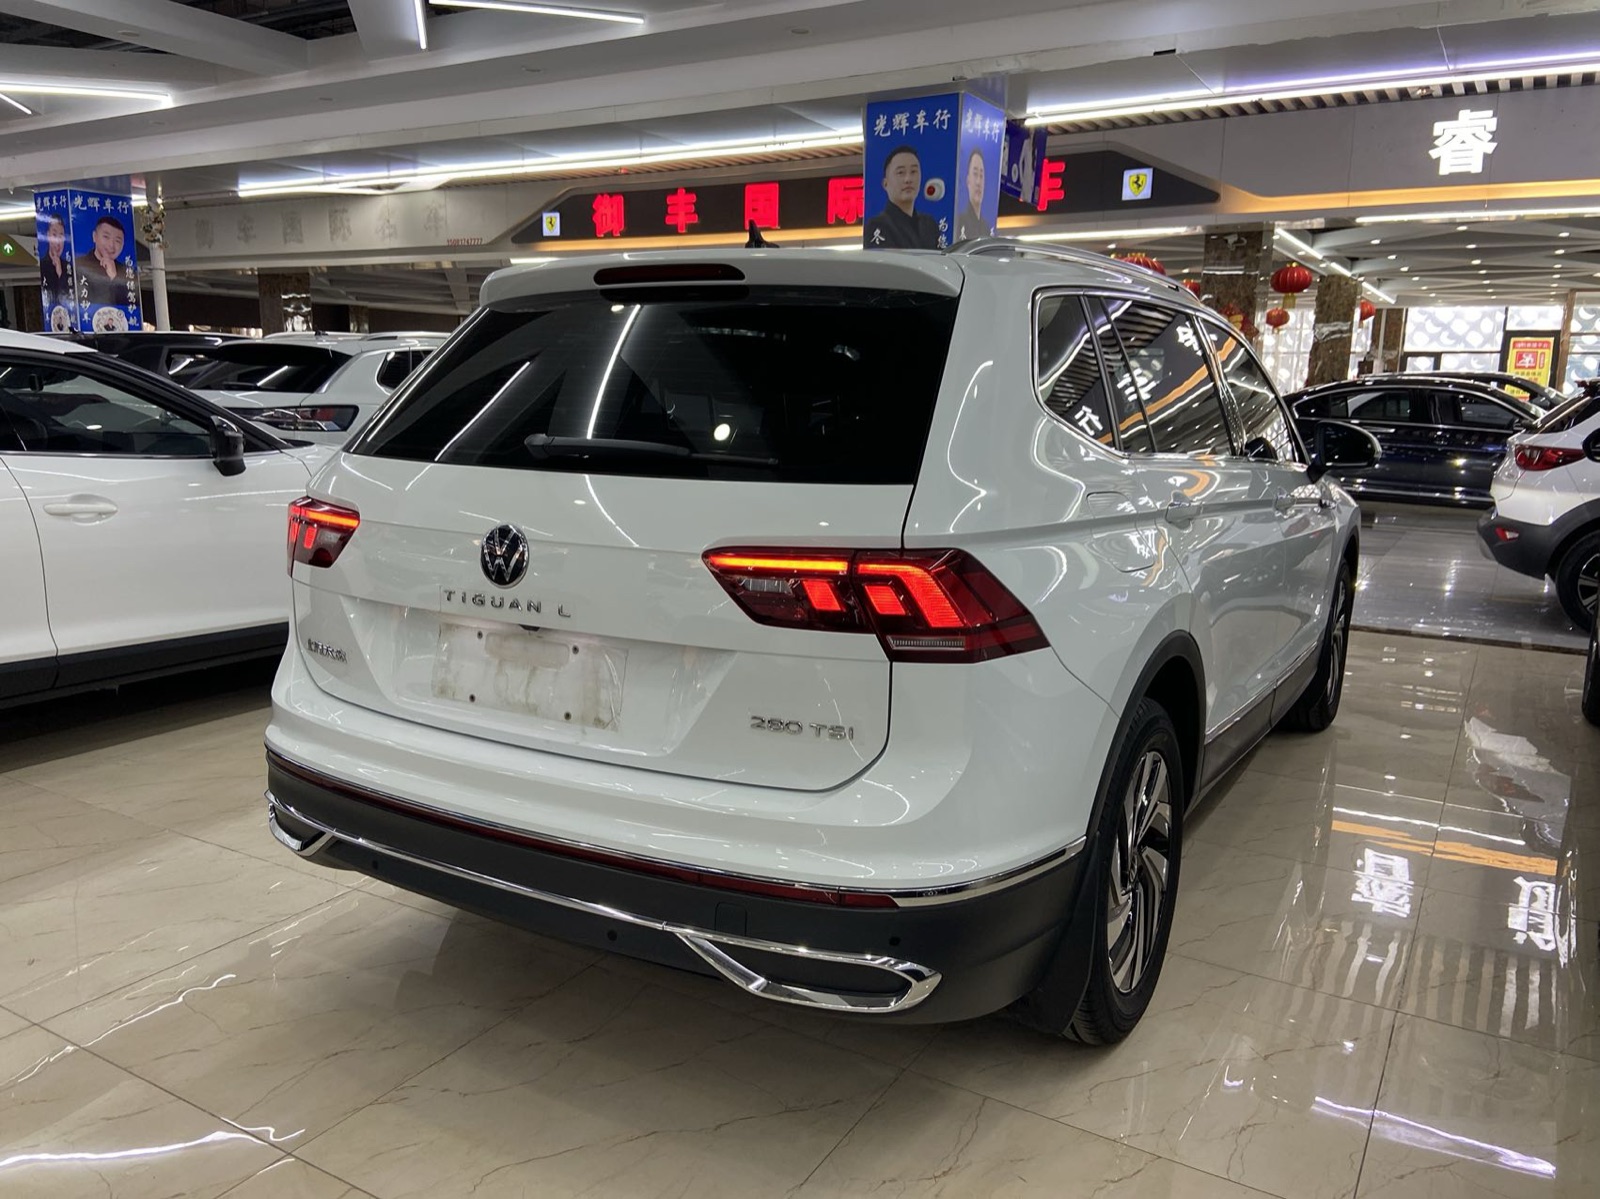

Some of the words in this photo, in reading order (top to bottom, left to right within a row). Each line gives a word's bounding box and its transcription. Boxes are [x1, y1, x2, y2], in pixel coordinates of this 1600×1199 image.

[873, 108, 951, 137] 光辉车行
[965, 108, 1000, 143] 光辉车行
[1428, 109, 1498, 175] 睿
[74, 194, 129, 214] 光辉车行
[443, 589, 542, 614] TIGUAN
[557, 604, 572, 618] L
[750, 715, 803, 735] 280
[808, 722, 854, 741] TSI
